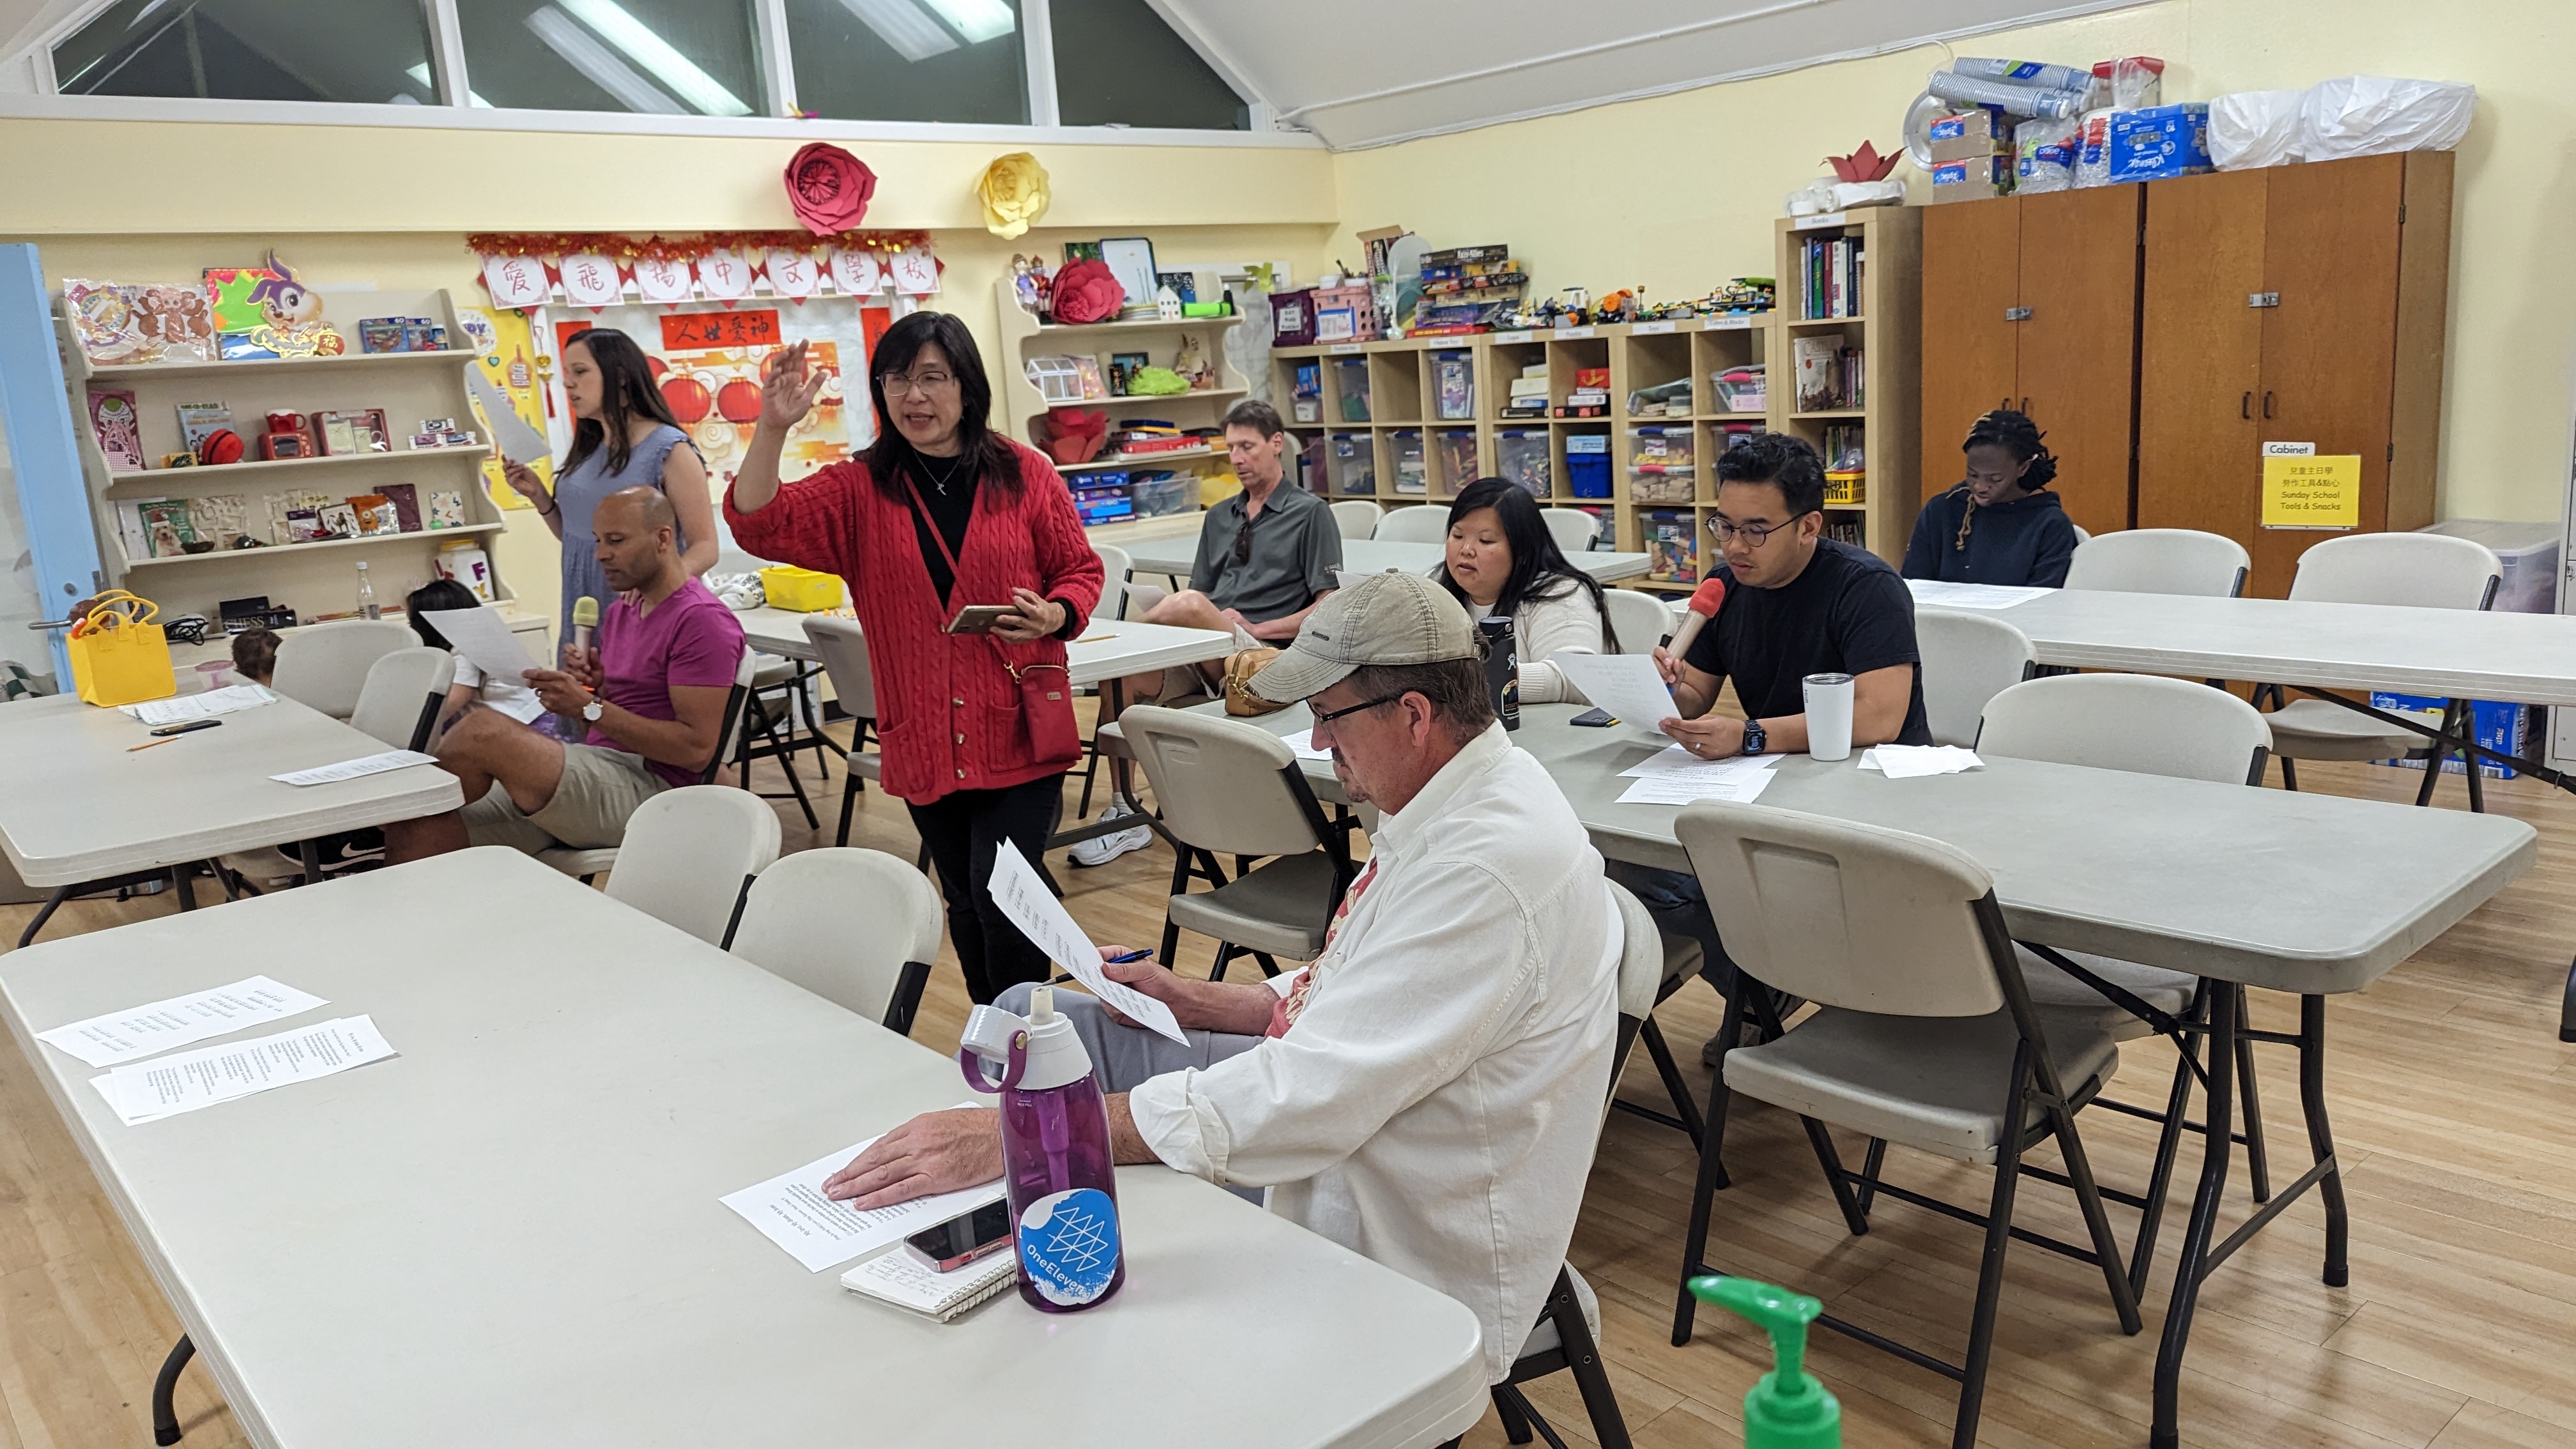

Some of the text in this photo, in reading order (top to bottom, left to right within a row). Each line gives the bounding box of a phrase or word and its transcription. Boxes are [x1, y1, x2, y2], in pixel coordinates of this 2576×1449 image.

[2128, 153, 2165, 169] Kleenex
[2269, 444, 2309, 454] Cabinet
[2281, 491, 2310, 500] Sunday
[2312, 502, 2341, 510] Snacks
